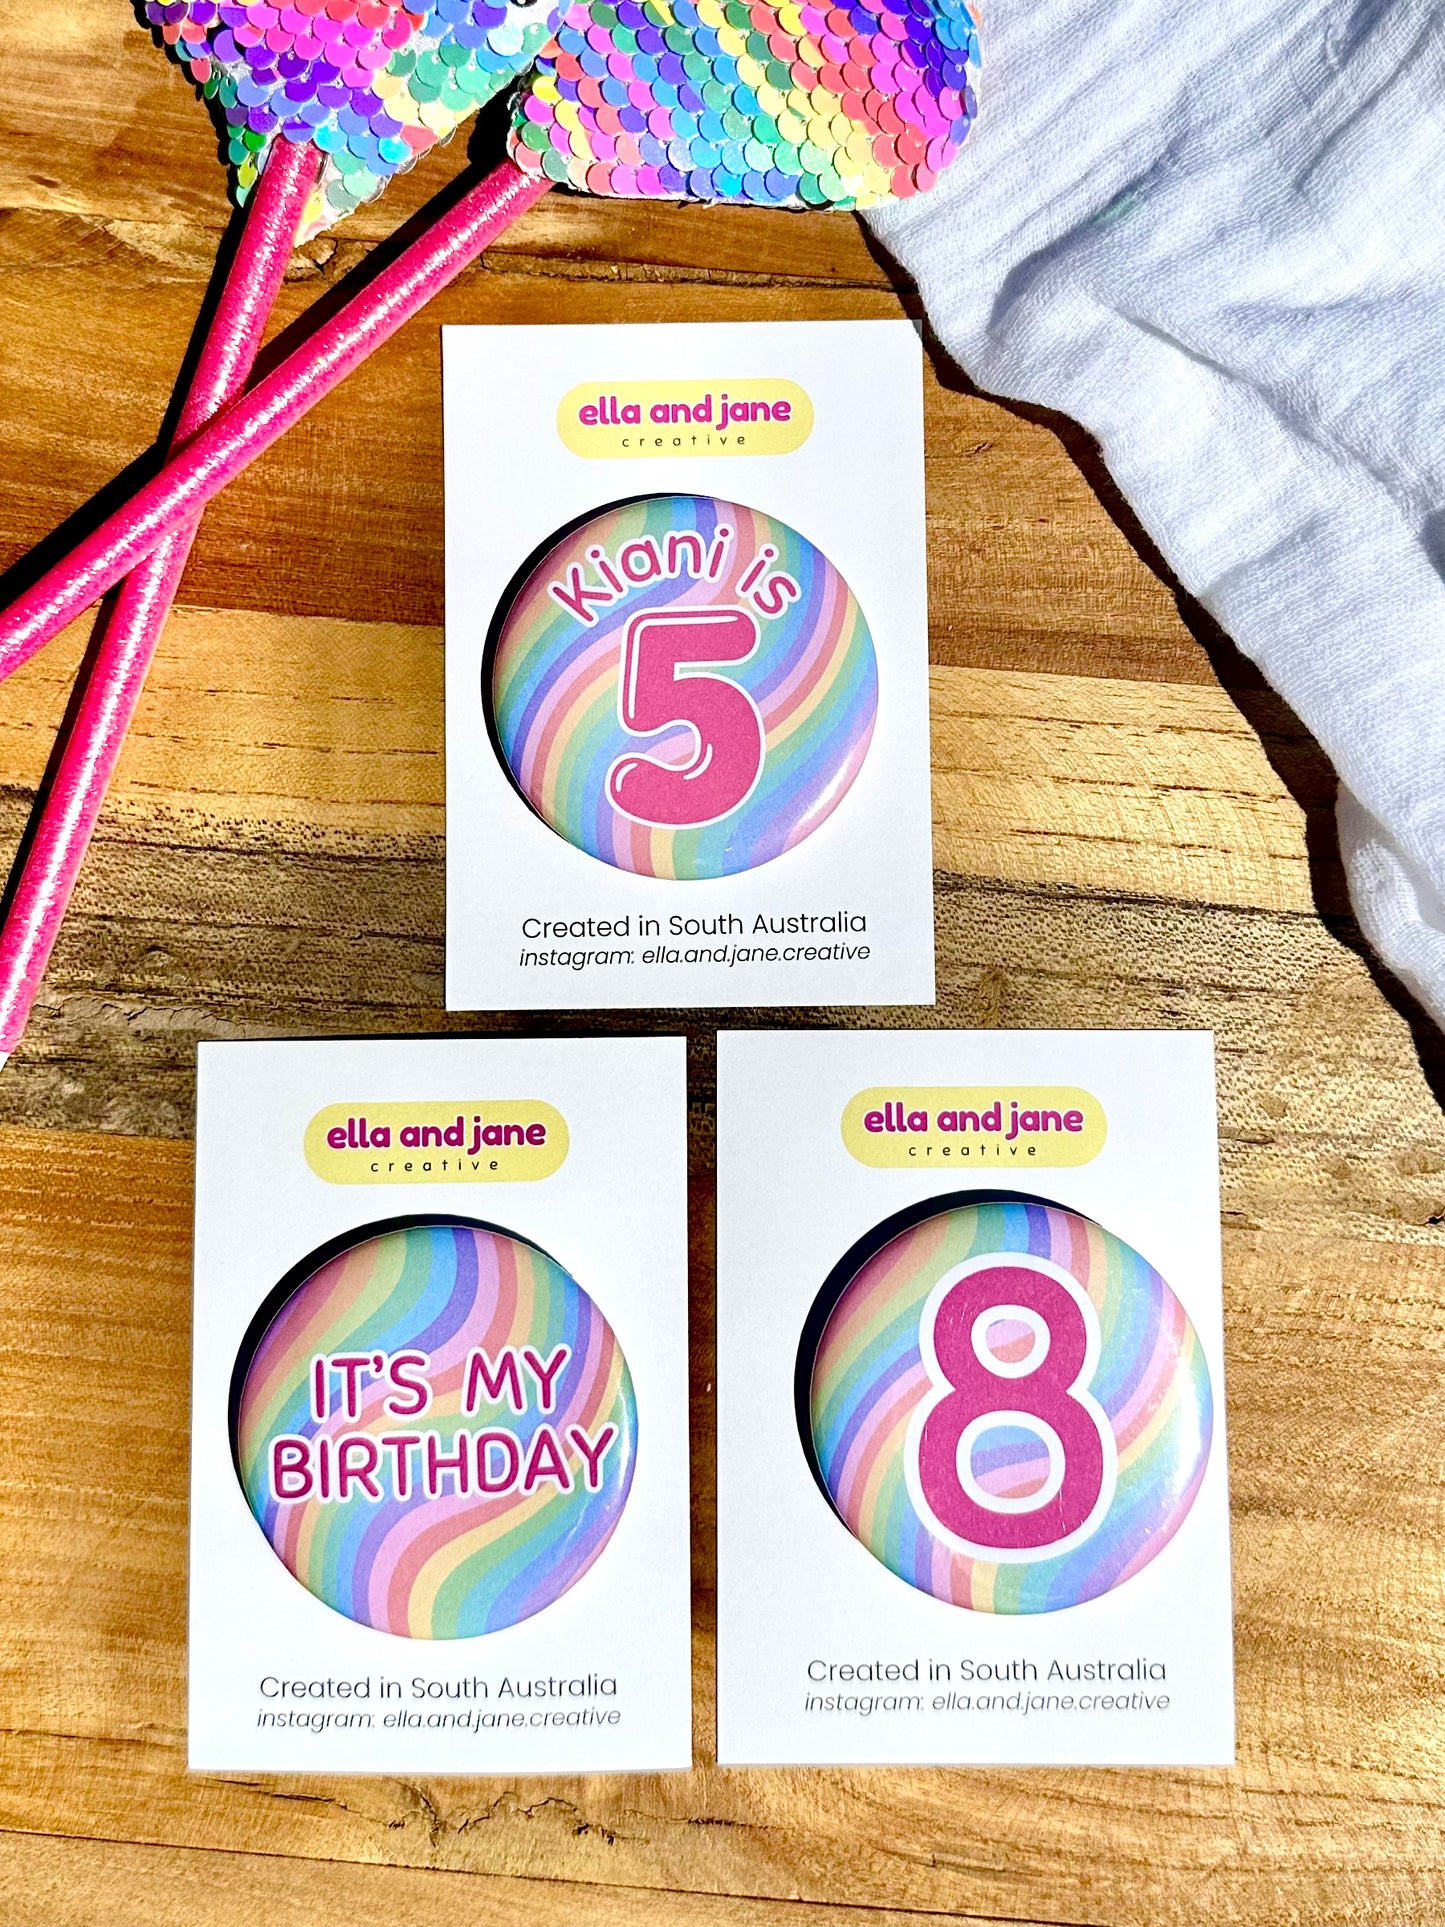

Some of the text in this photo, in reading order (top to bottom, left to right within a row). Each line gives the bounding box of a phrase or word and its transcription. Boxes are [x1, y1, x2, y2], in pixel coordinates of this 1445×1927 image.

[579, 394, 791, 430] ella and jane
[622, 435, 745, 447] creative
[552, 528, 798, 622] Kiani is
[611, 609, 762, 825] 5
[522, 911, 866, 938] Created in South Australia
[520, 943, 870, 971] instagram: ella.and.jane.creative
[864, 1102, 1083, 1140] ella and jane
[327, 1116, 546, 1155] ella and jane
[909, 1144, 1035, 1156] creative
[371, 1159, 498, 1172] creative
[314, 1348, 568, 1418] IT'S MY
[918, 1266, 1103, 1548] 8
[272, 1428, 614, 1499] BIRTHDAY
[808, 1658, 1165, 1681] Created in South Australia
[260, 1674, 616, 1698] Created in South Australia
[806, 1692, 1169, 1716] instagram: ella.and.jane.creative
[257, 1708, 620, 1733] instagram: ella.and.jane.creative
